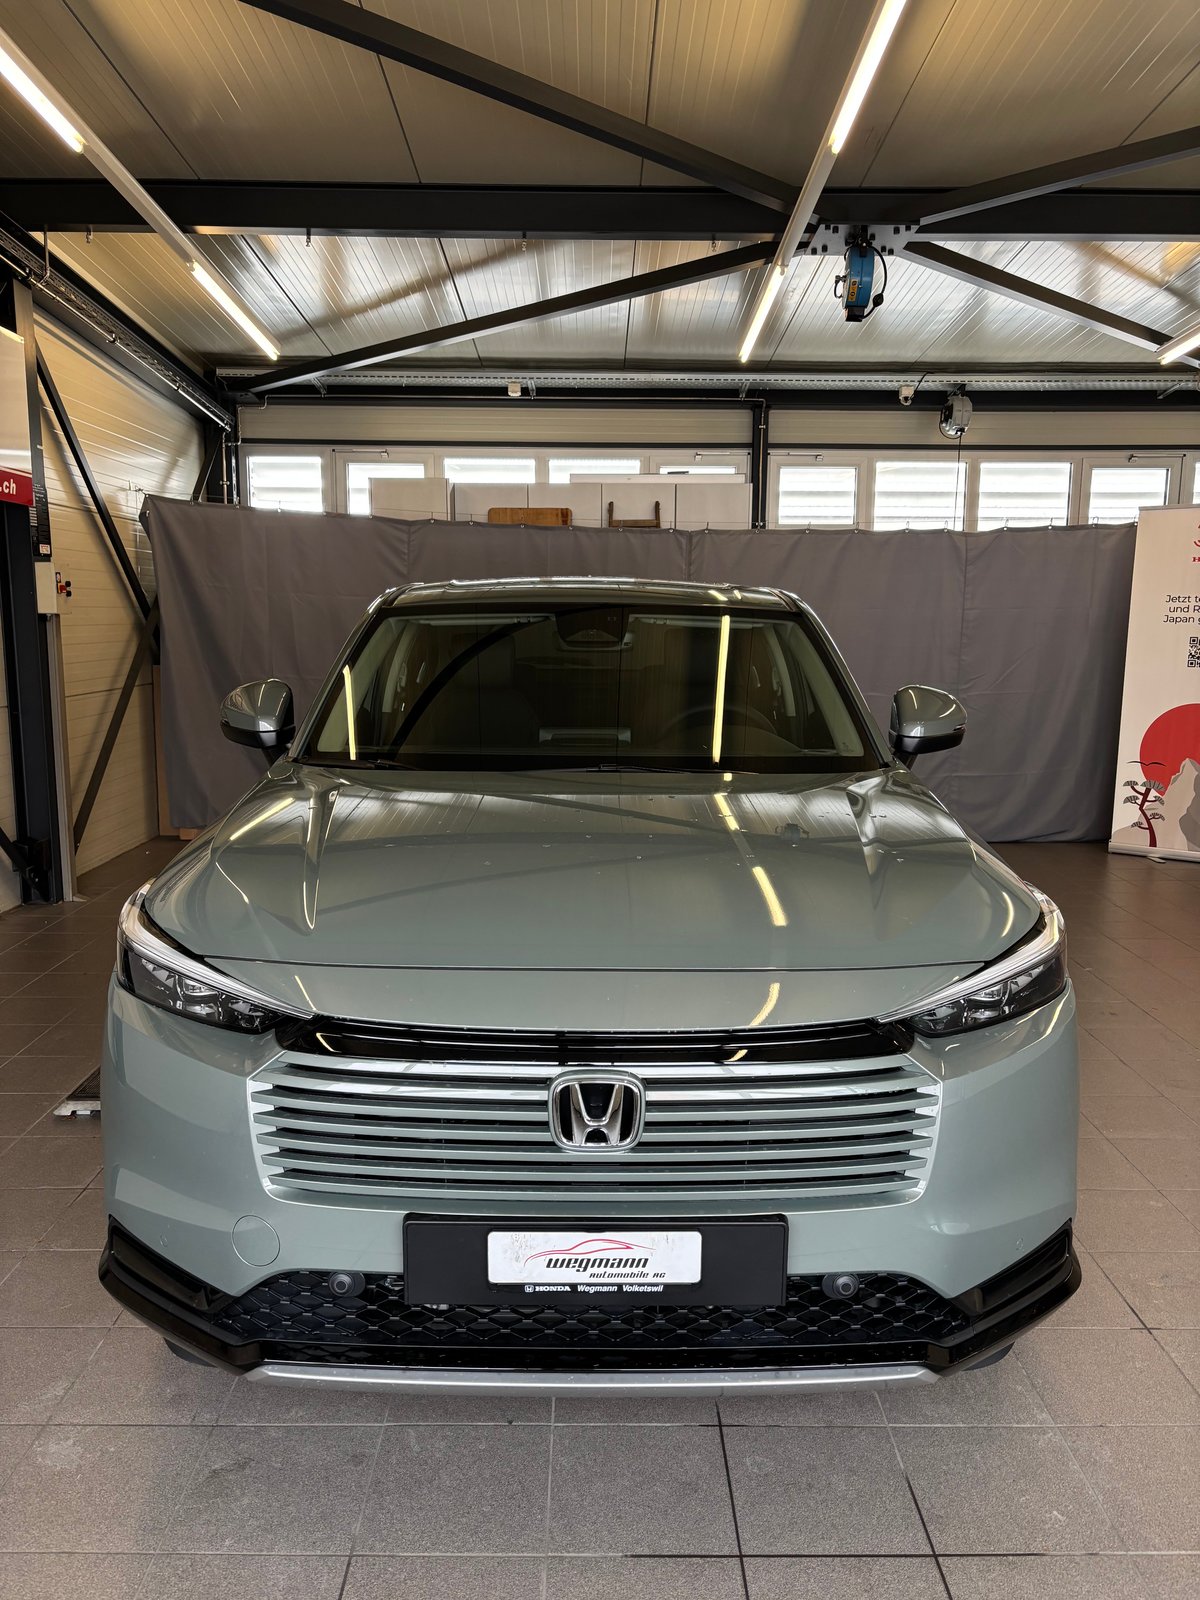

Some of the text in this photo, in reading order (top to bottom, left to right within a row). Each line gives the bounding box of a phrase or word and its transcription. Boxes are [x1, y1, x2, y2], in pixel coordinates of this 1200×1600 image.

[1165, 595, 1200, 603] Jetzt t
[1169, 605, 1189, 613] und
[1163, 615, 1194, 624] Japan
[546, 1257, 649, 1272] wegmann
[577, 1285, 617, 1293] Wegmann
